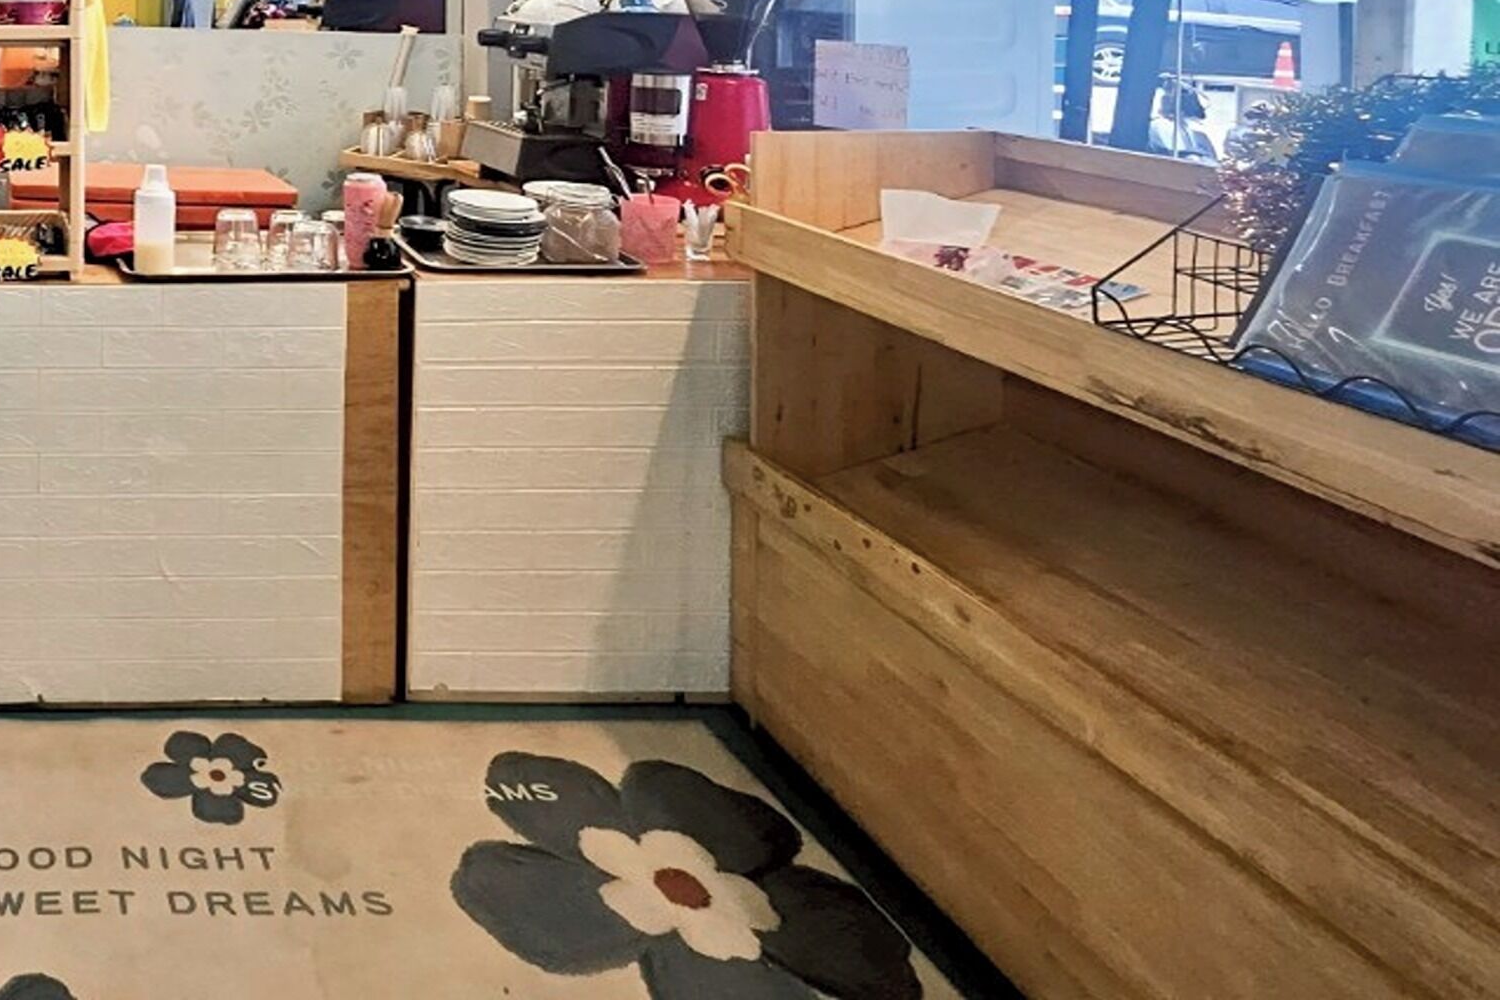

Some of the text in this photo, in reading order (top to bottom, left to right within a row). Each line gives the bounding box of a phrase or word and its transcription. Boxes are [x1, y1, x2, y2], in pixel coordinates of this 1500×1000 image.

[0, 156, 48, 173] SALE
[1449, 309, 1485, 340] WE
[122, 845, 277, 871] NIGHT
[168, 889, 395, 916] DREAMS
